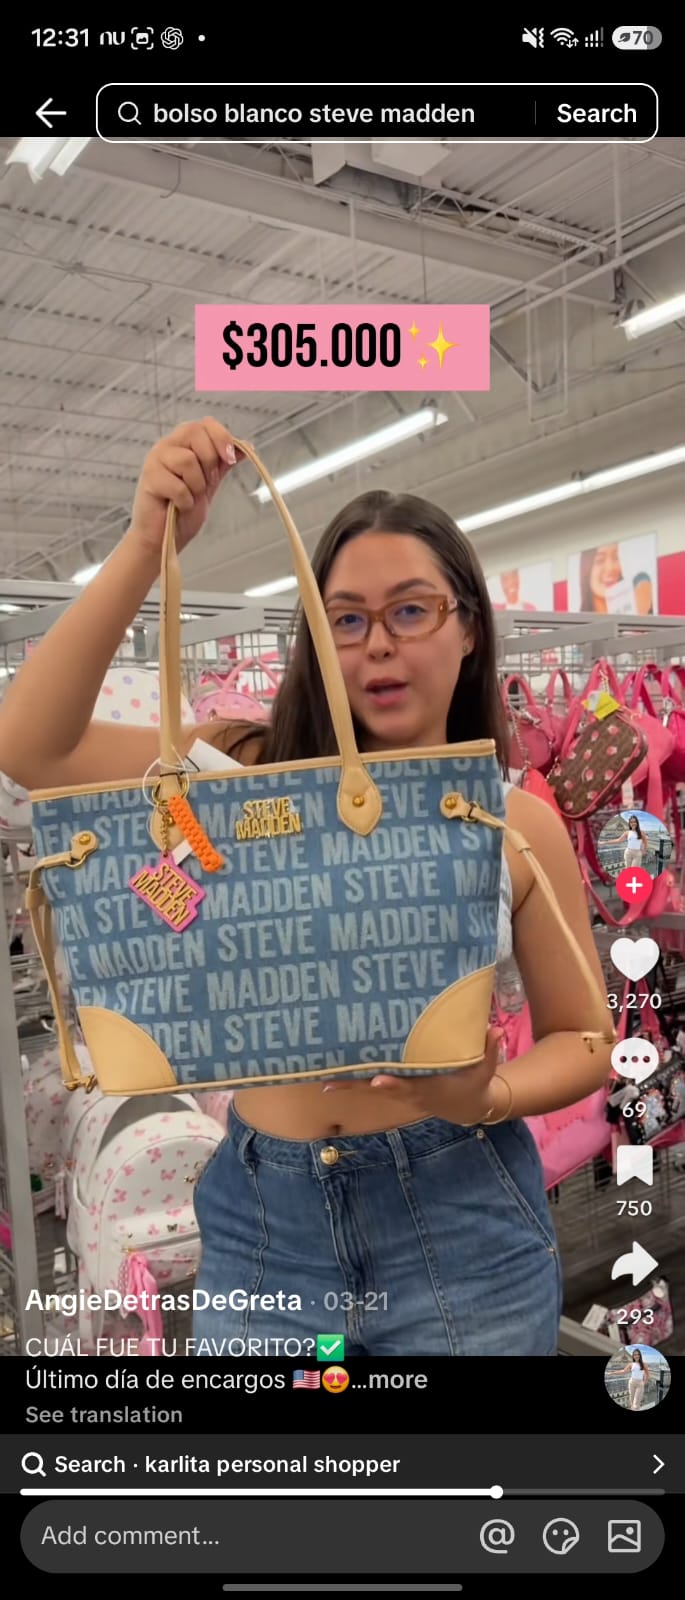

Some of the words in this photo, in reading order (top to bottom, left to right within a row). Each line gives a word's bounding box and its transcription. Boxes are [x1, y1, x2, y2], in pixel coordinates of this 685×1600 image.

[235, 812, 303, 840] MADDEN
[242, 796, 291, 819] STEVE
[320, 822, 450, 867] MADDEN
[131, 870, 191, 927] MADDEN
[153, 863, 199, 904] STEVE
[203, 871, 333, 921] MADDEN
[344, 861, 441, 904] STEVE
[88, 928, 206, 979] MADDEN
[216, 914, 316, 962] STEVE
[328, 903, 459, 952] MADDEN
[113, 973, 193, 1015] STEVE
[205, 957, 341, 1012] MADDEN
[351, 947, 448, 995] STEVE
[223, 1005, 323, 1054] STEVE
